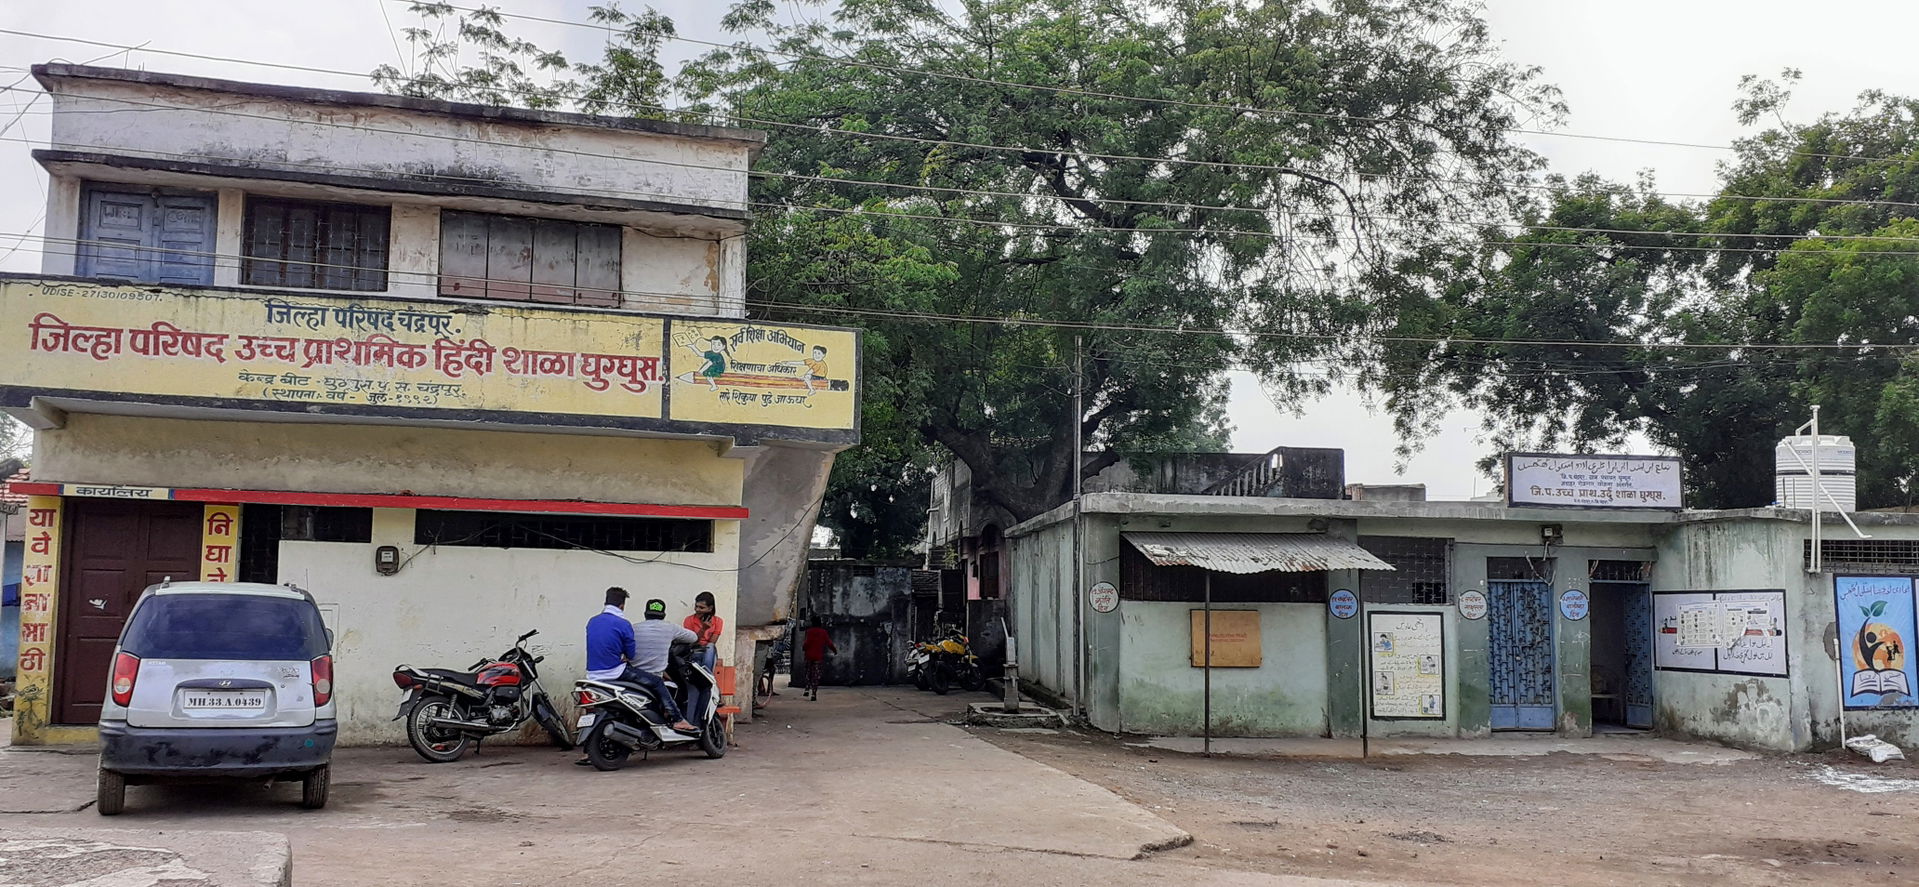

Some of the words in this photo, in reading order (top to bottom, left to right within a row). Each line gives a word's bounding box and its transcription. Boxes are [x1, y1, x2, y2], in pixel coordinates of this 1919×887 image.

[265, 300, 329, 331] जिल्हा
[333, 304, 395, 332] परिषद
[397, 306, 461, 339] चंद्रपूर.
[729, 327, 746, 352] सर्व
[746, 326, 766, 343] शिक्षा
[767, 329, 806, 354] अभियान
[28, 312, 124, 360] जिल्हा
[129, 321, 229, 363] परिषद
[235, 335, 300, 363] उच्च
[301, 334, 427, 369] प्राथमिक
[432, 338, 497, 378] हिंदी
[502, 347, 576, 376] शाळा
[580, 353, 664, 394] घुग्घुस.
[730, 360, 766, 373] शिक्षणाचा
[767, 362, 797, 375] अधिकार
[280, 372, 311, 386] बीट
[1616, 489, 1637, 499] शाळा
